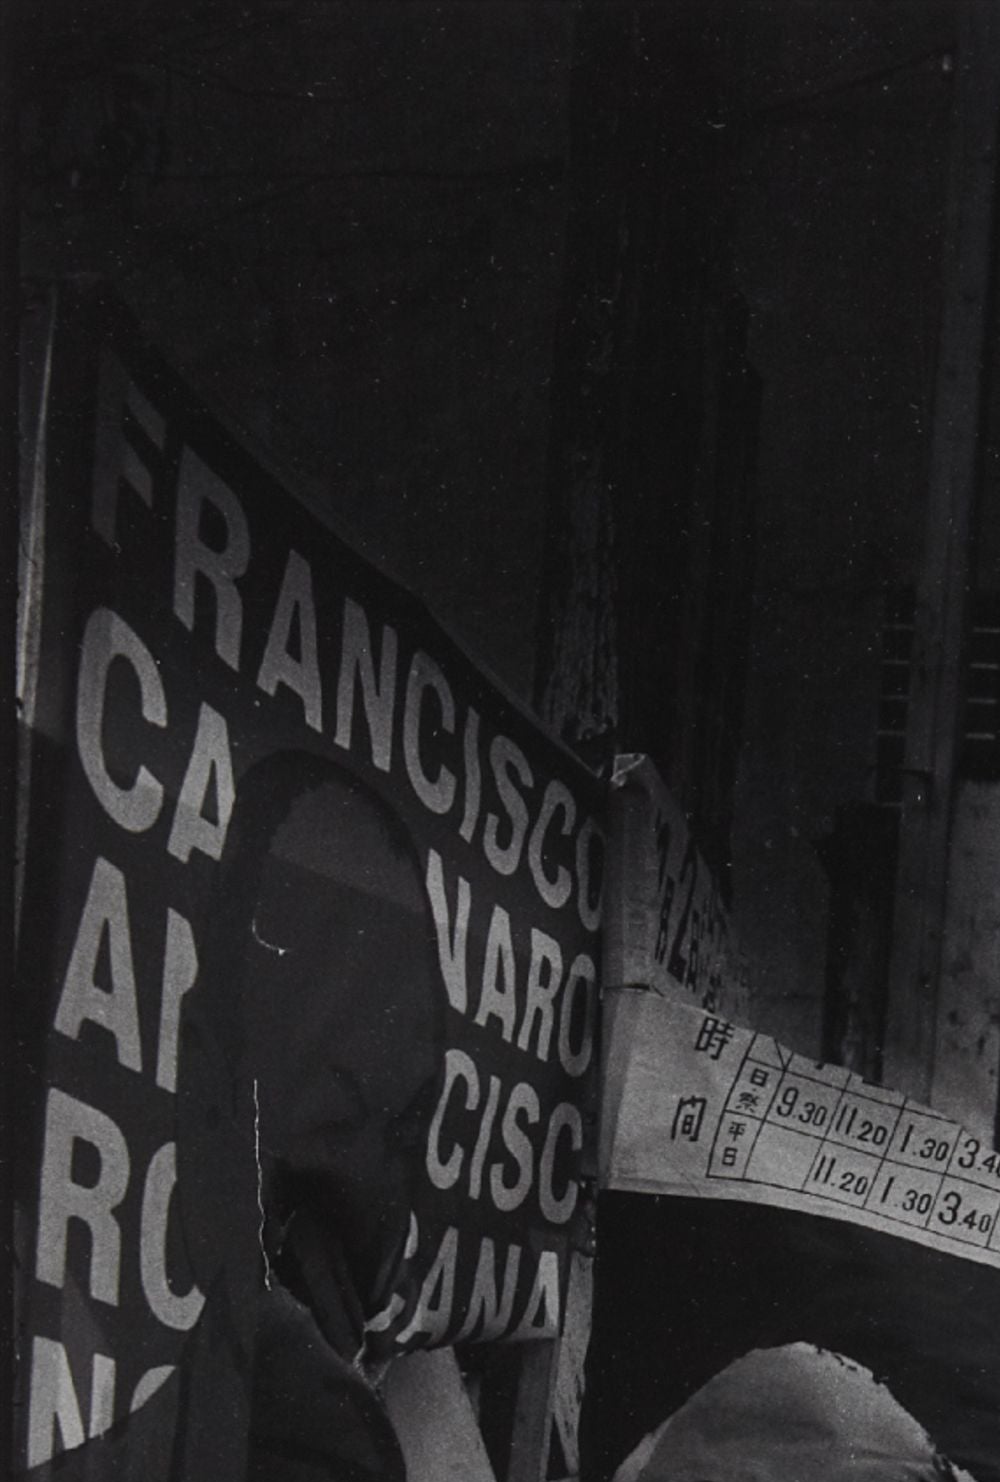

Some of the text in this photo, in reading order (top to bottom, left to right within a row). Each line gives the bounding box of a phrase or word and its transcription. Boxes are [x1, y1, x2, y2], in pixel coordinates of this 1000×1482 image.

[92, 345, 603, 932] FRANCISCO
[720, 1121, 748, 1168] 平日
[811, 1155, 869, 1196] 11.20
[880, 1176, 933, 1215] 1.30
[937, 1191, 992, 1234] 3.40
[776, 1089, 827, 1127] 9.30
[834, 1106, 888, 1146] 11.20
[900, 1124, 950, 1163] 1.30
